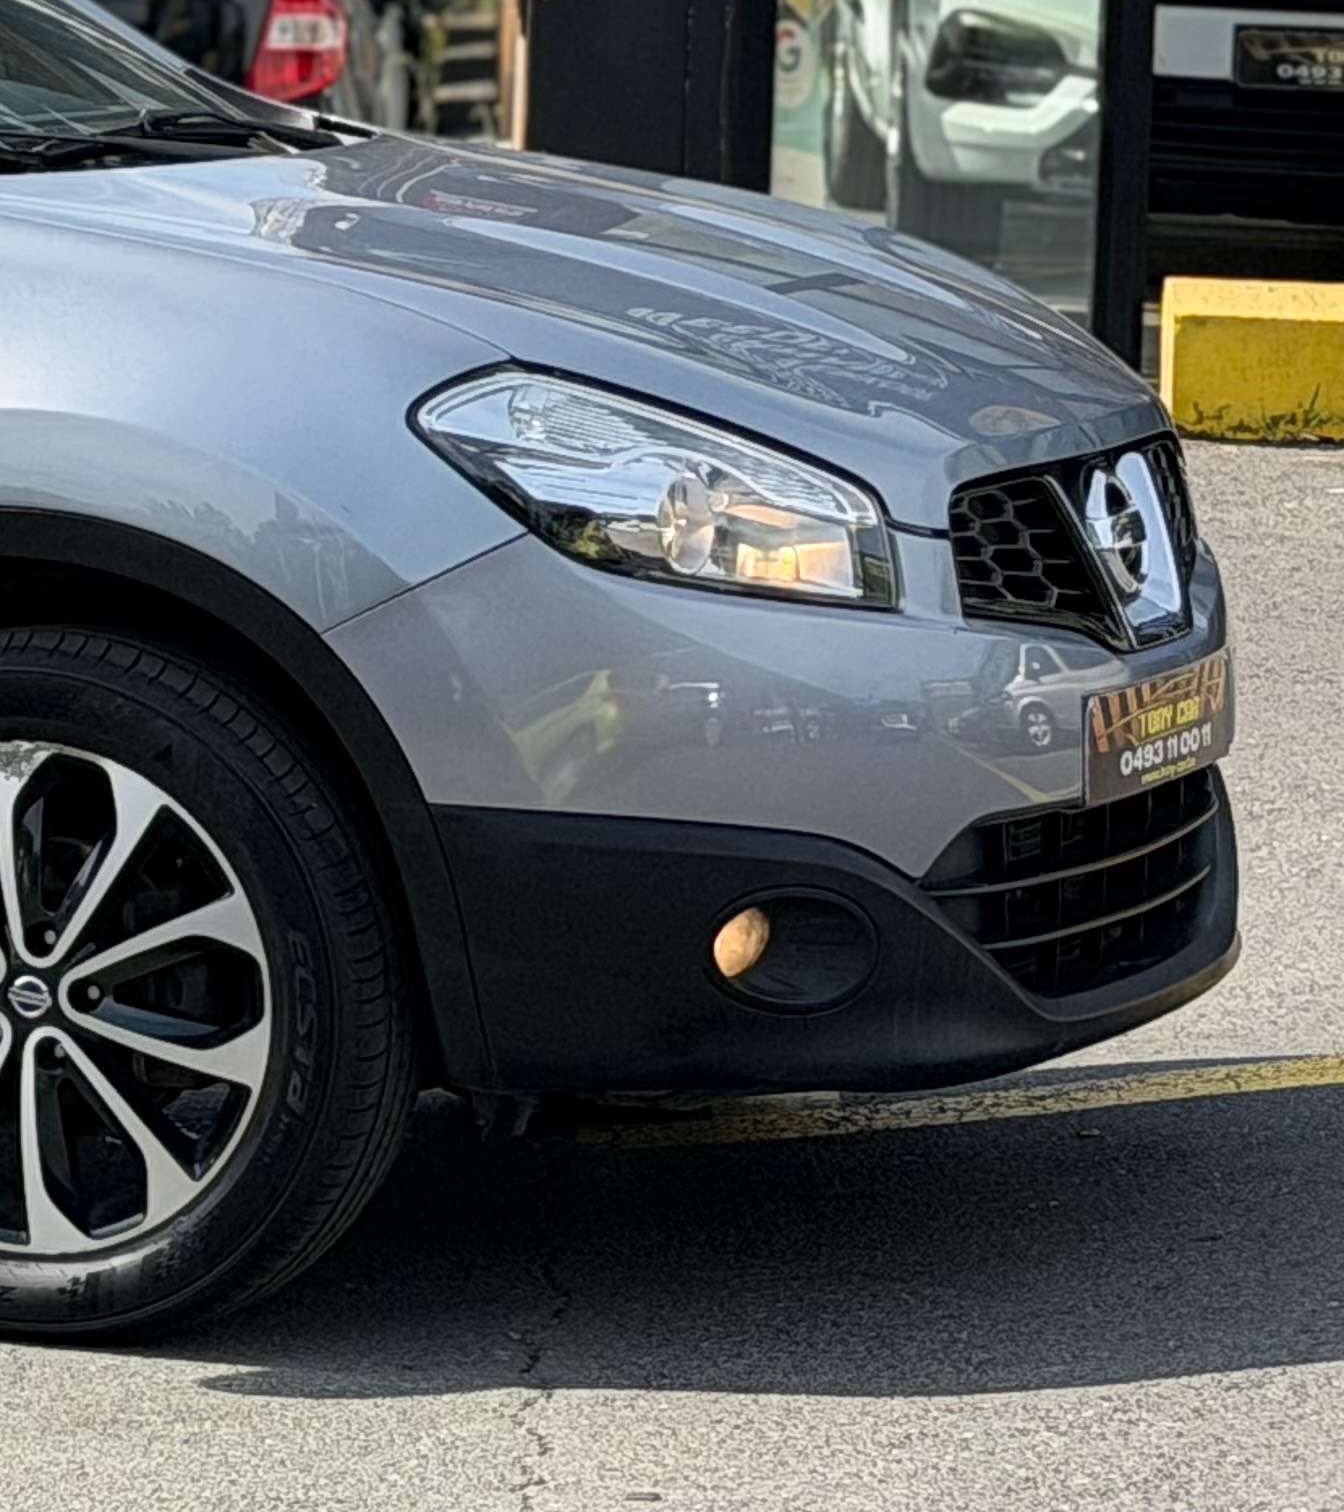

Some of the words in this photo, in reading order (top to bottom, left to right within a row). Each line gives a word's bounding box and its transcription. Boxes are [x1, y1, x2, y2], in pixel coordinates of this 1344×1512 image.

[1120, 740, 1164, 777] 0493
[1167, 733, 1179, 760] 11
[1180, 726, 1200, 756] 00
[1201, 721, 1212, 747] 11
